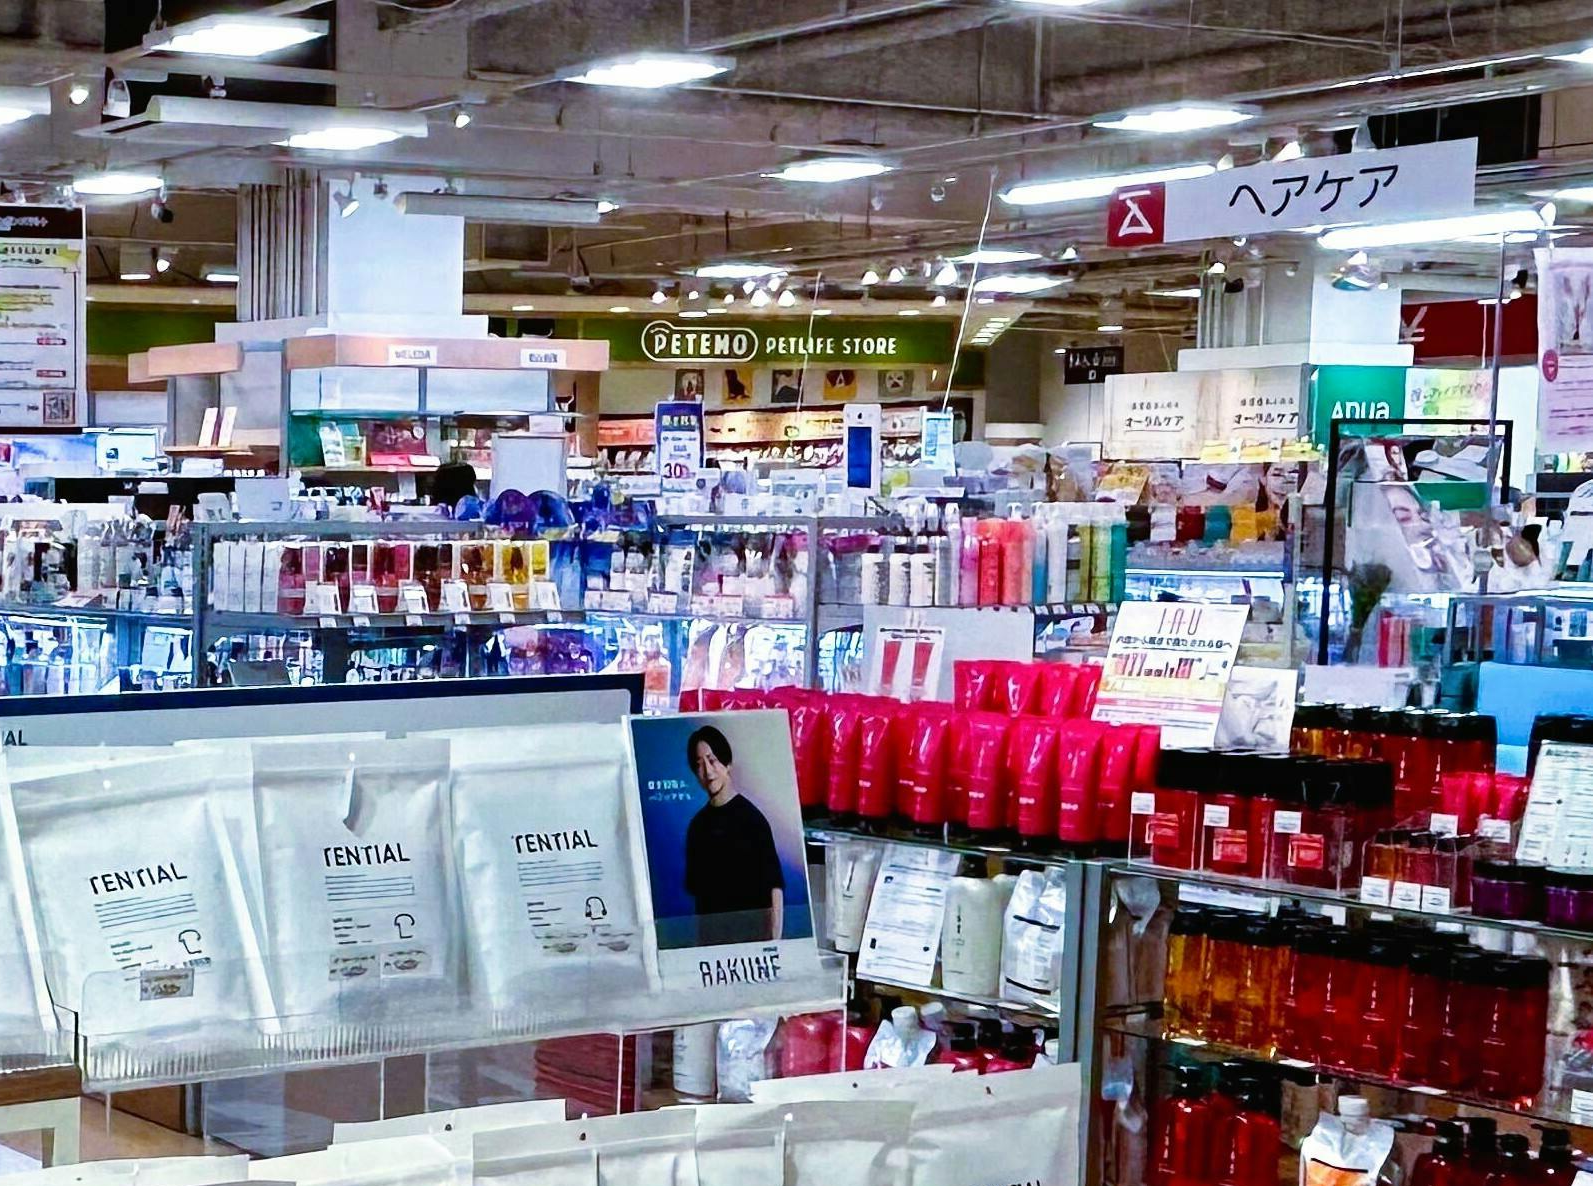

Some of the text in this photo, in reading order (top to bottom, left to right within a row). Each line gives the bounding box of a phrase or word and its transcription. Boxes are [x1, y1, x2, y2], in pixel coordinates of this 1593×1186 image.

[1228, 164, 1399, 217] ヘアケア
[654, 333, 749, 355] PETEMO
[765, 336, 897, 355] PETLIFE STORE
[513, 828, 599, 855] TENTIAL
[323, 842, 411, 868] TENTIAL
[90, 861, 188, 896] TENTIAL
